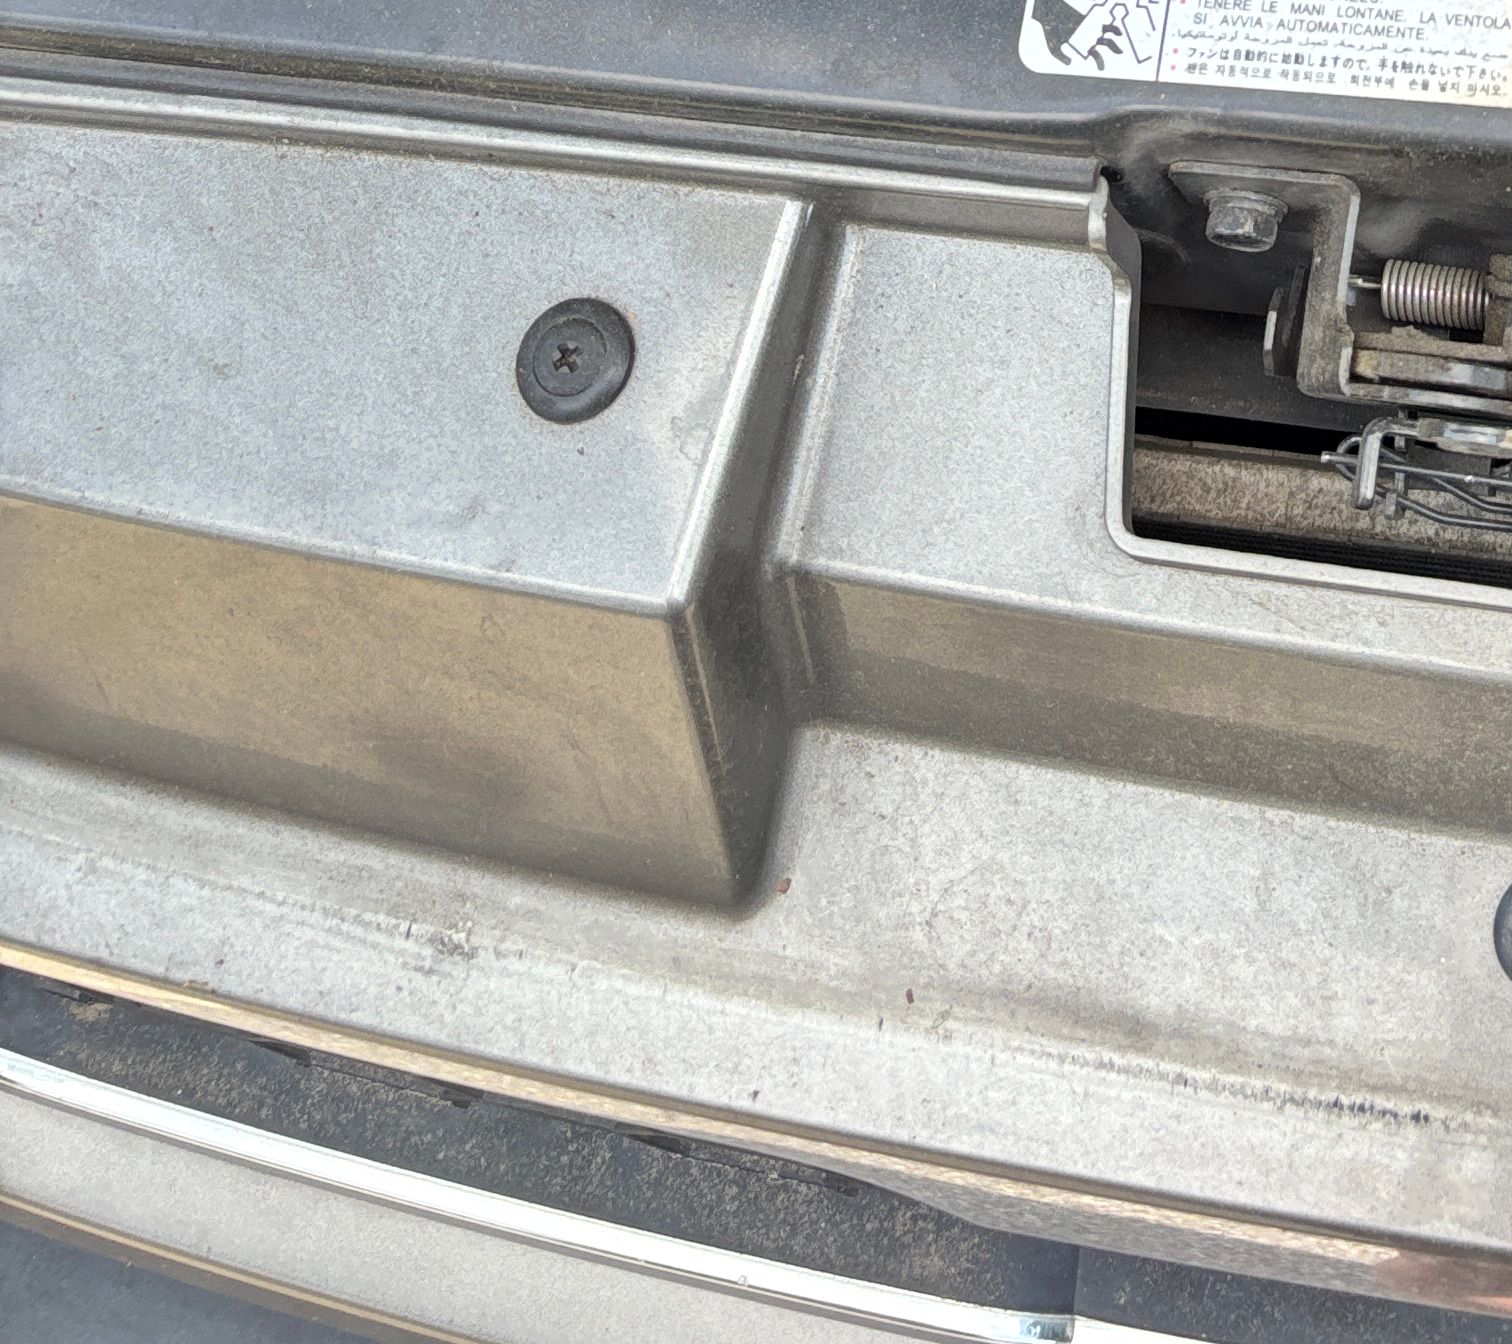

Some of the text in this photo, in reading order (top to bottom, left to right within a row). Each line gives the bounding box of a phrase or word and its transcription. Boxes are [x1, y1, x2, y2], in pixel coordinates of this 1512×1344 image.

[1193, 12, 1429, 40] SI AVVIA AUTOMATICAMENTE.
[1260, 0, 1278, 13] LE
[1290, 2, 1325, 16] MANI
[1419, 11, 1437, 24] LA
[1444, 12, 1512, 29] VENTOLA
